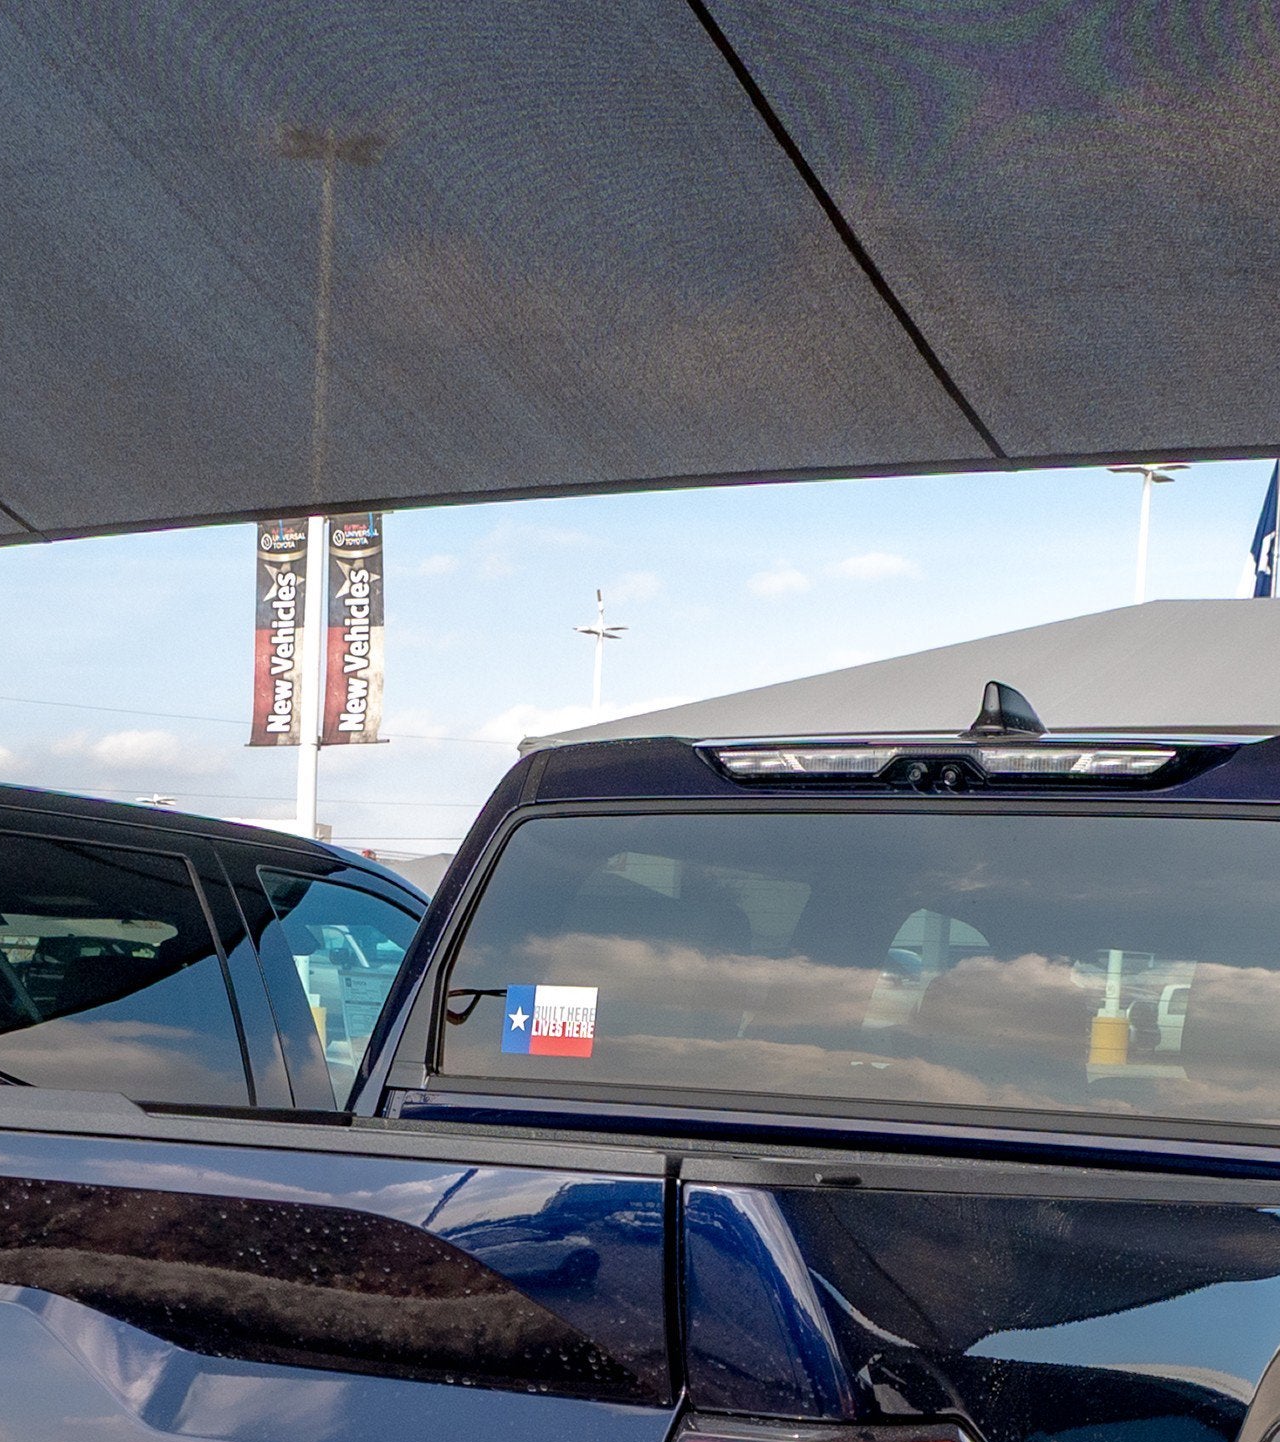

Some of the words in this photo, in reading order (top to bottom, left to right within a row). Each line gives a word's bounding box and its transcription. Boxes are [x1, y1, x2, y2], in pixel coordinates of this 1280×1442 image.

[273, 540, 296, 550] TOYOTA
[345, 537, 369, 546] TOYOTA
[270, 571, 296, 675] Vehicles
[343, 568, 370, 673] Vehicles
[267, 679, 292, 733] New
[339, 677, 368, 732] New
[532, 1019, 564, 1037] LIVES
[565, 1021, 595, 1039] HERE
[535, 1005, 565, 1022] BUILT
[567, 1006, 596, 1023] HERE
